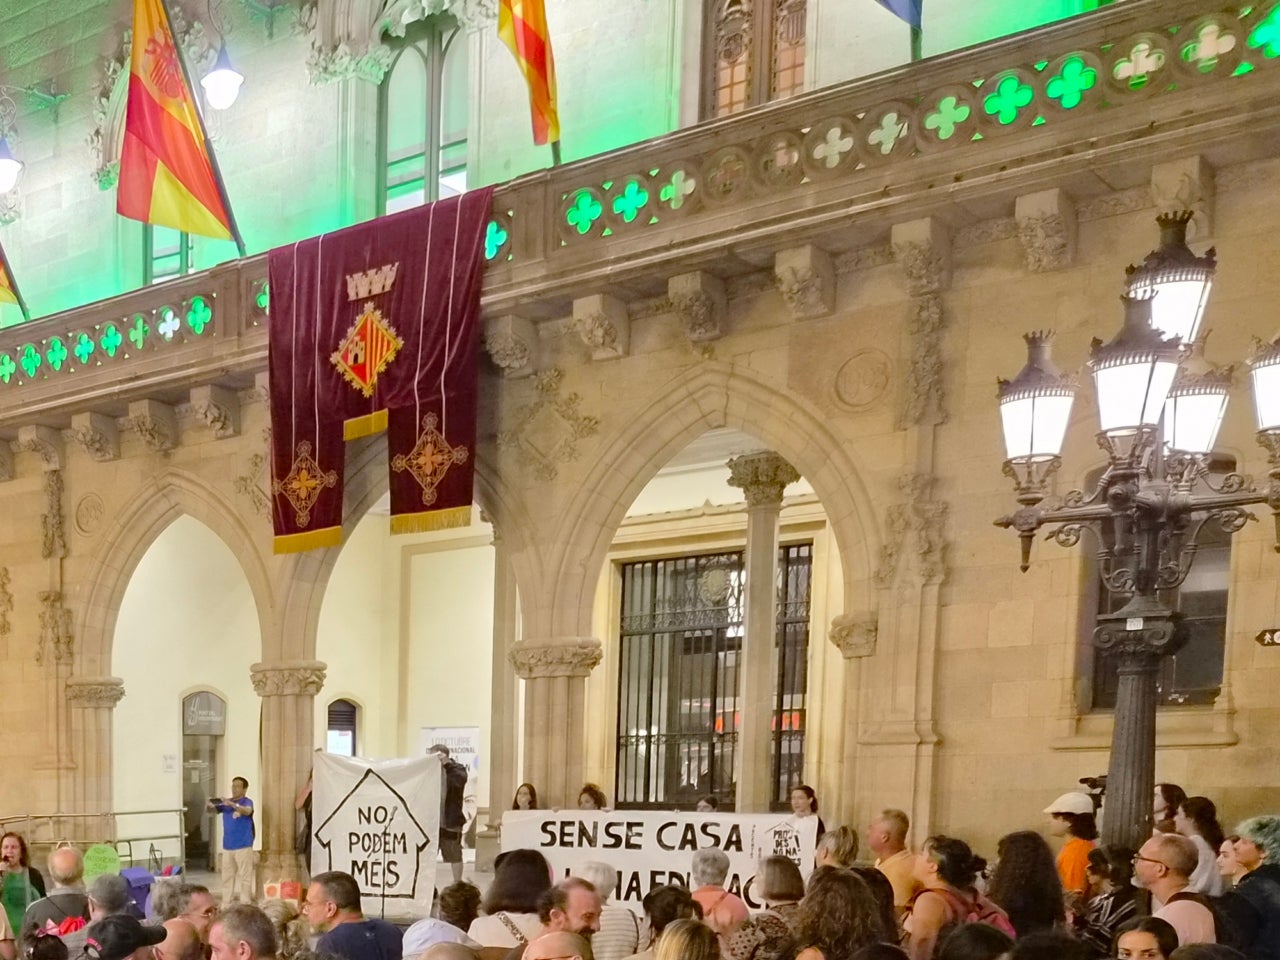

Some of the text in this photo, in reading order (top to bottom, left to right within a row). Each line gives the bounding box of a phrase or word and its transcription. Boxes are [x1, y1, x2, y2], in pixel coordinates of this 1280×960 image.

[357, 805, 388, 825] NO
[348, 832, 408, 854] PODEM
[540, 820, 644, 850] SENSE
[656, 821, 744, 852] CASA
